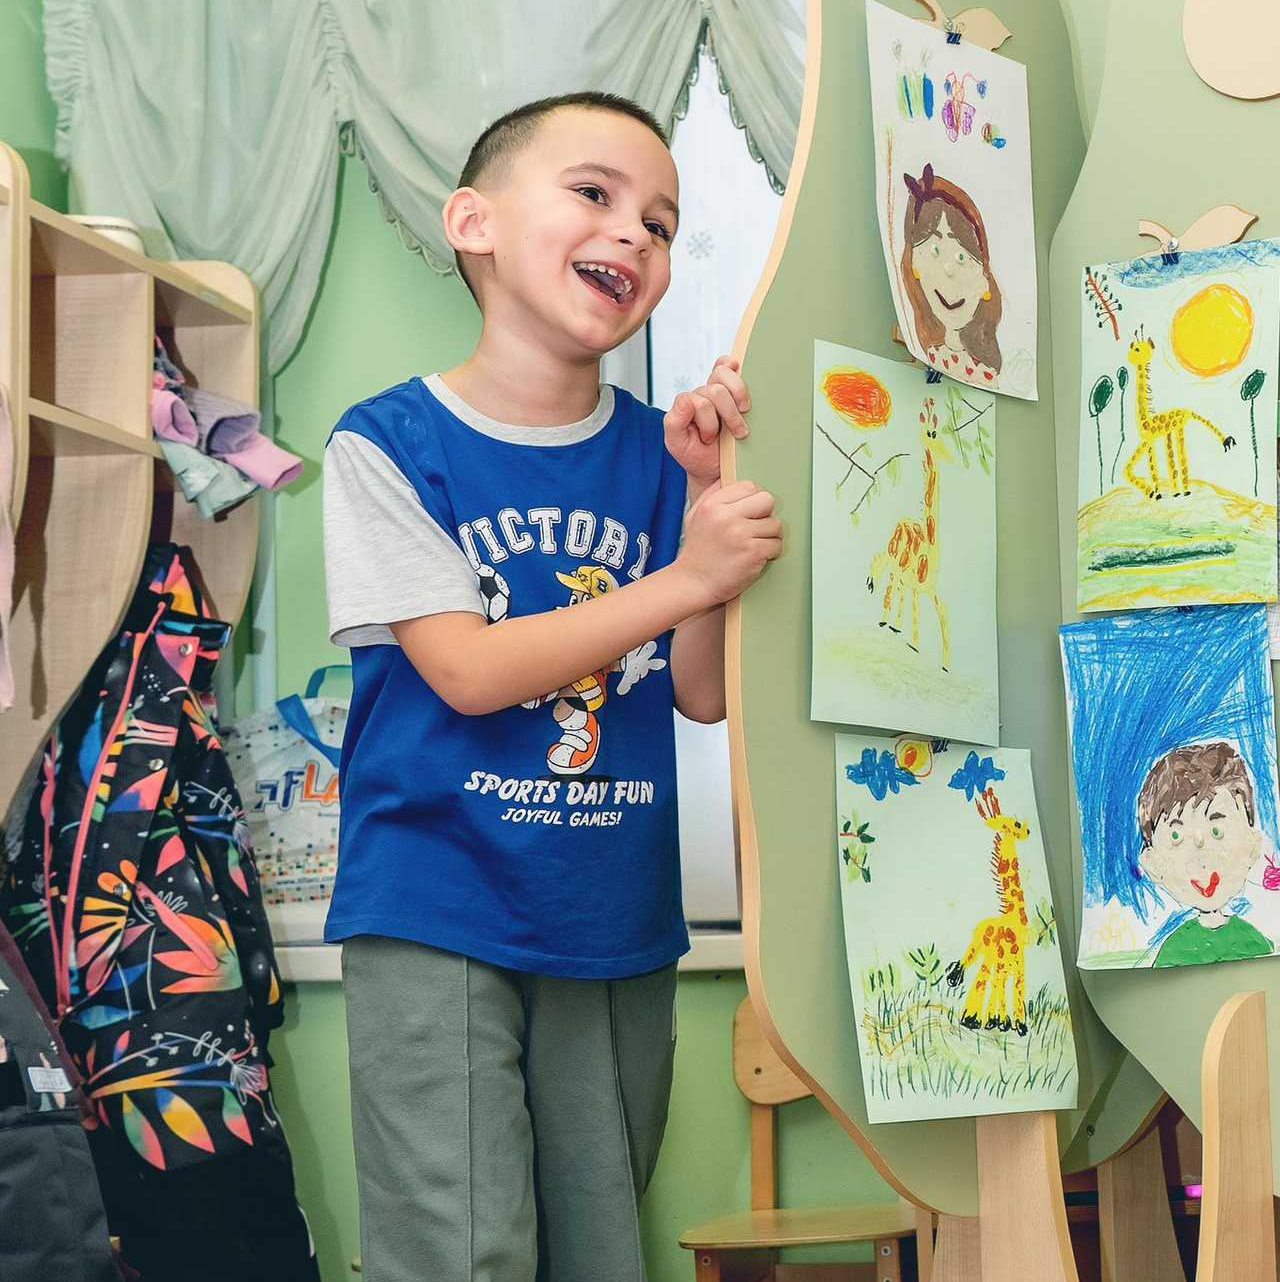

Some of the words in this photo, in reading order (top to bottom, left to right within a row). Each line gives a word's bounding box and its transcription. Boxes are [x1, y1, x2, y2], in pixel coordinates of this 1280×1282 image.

[464, 771, 560, 804] SPORTS
[566, 781, 609, 805] DAY
[613, 781, 655, 804] FUN
[501, 808, 563, 825] JOYFUL
[569, 811, 622, 826] GAMES!
